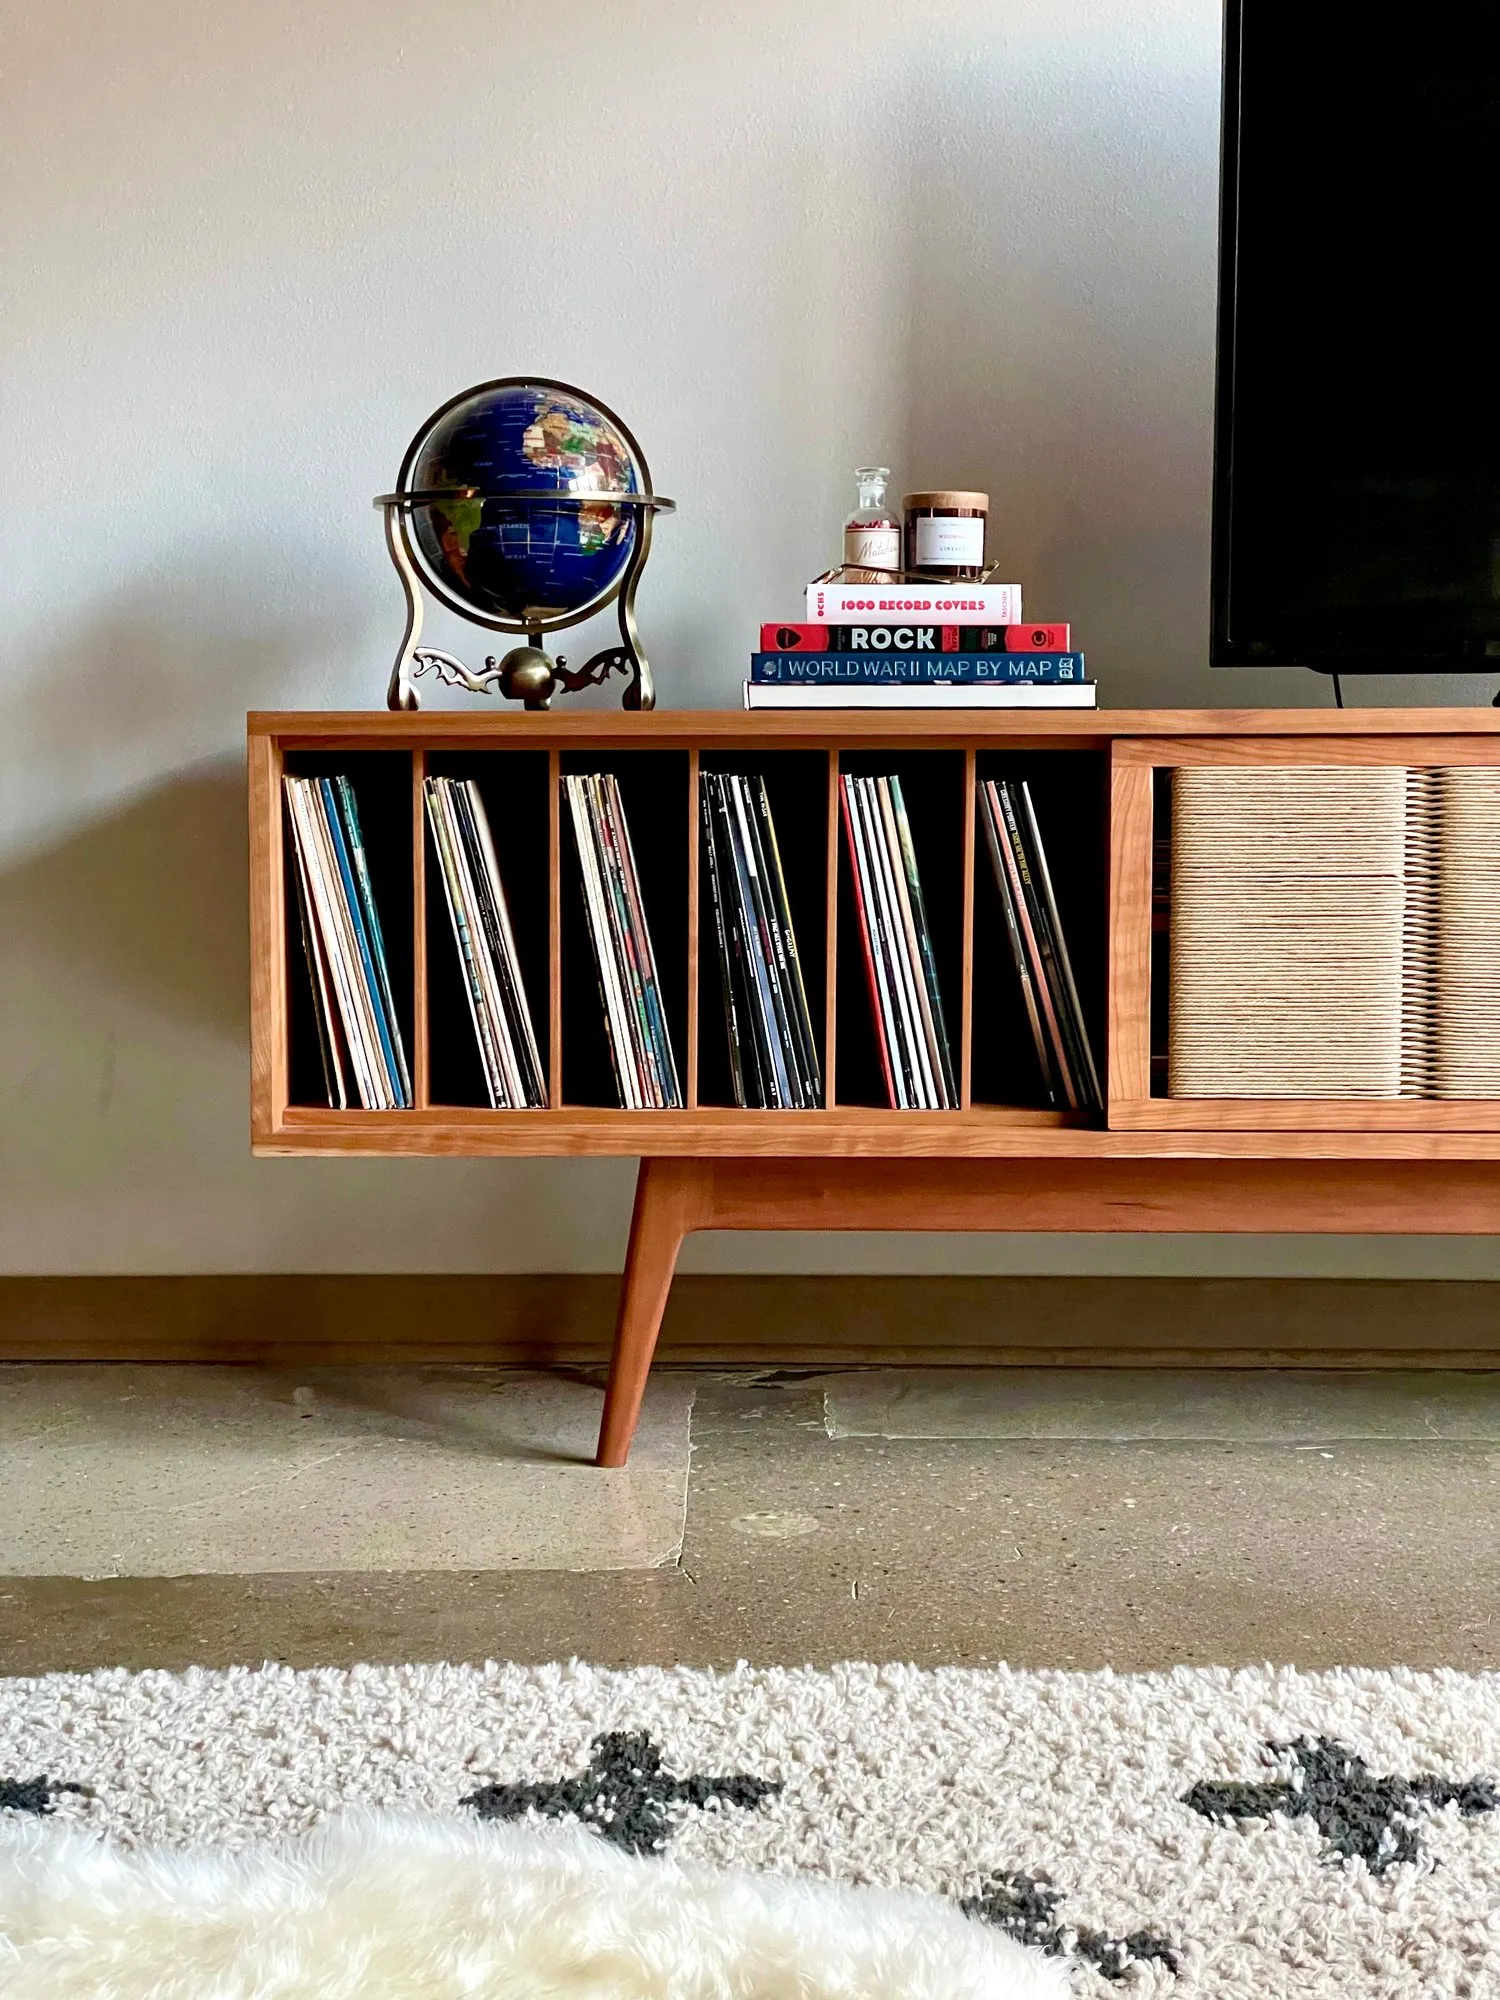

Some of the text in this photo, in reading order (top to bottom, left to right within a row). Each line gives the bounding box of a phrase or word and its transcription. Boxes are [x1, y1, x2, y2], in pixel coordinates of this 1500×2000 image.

[817, 592, 825, 617] OCHS
[841, 600, 986, 611] 1000 RECORD COVERS
[851, 628, 936, 650] ROCK
[788, 660, 860, 676] WORLD
[863, 660, 907, 676] WAR
[910, 661, 920, 676] II
[927, 661, 971, 676] MAP
[976, 661, 1002, 676] BY
[1009, 661, 1053, 676] MAP
